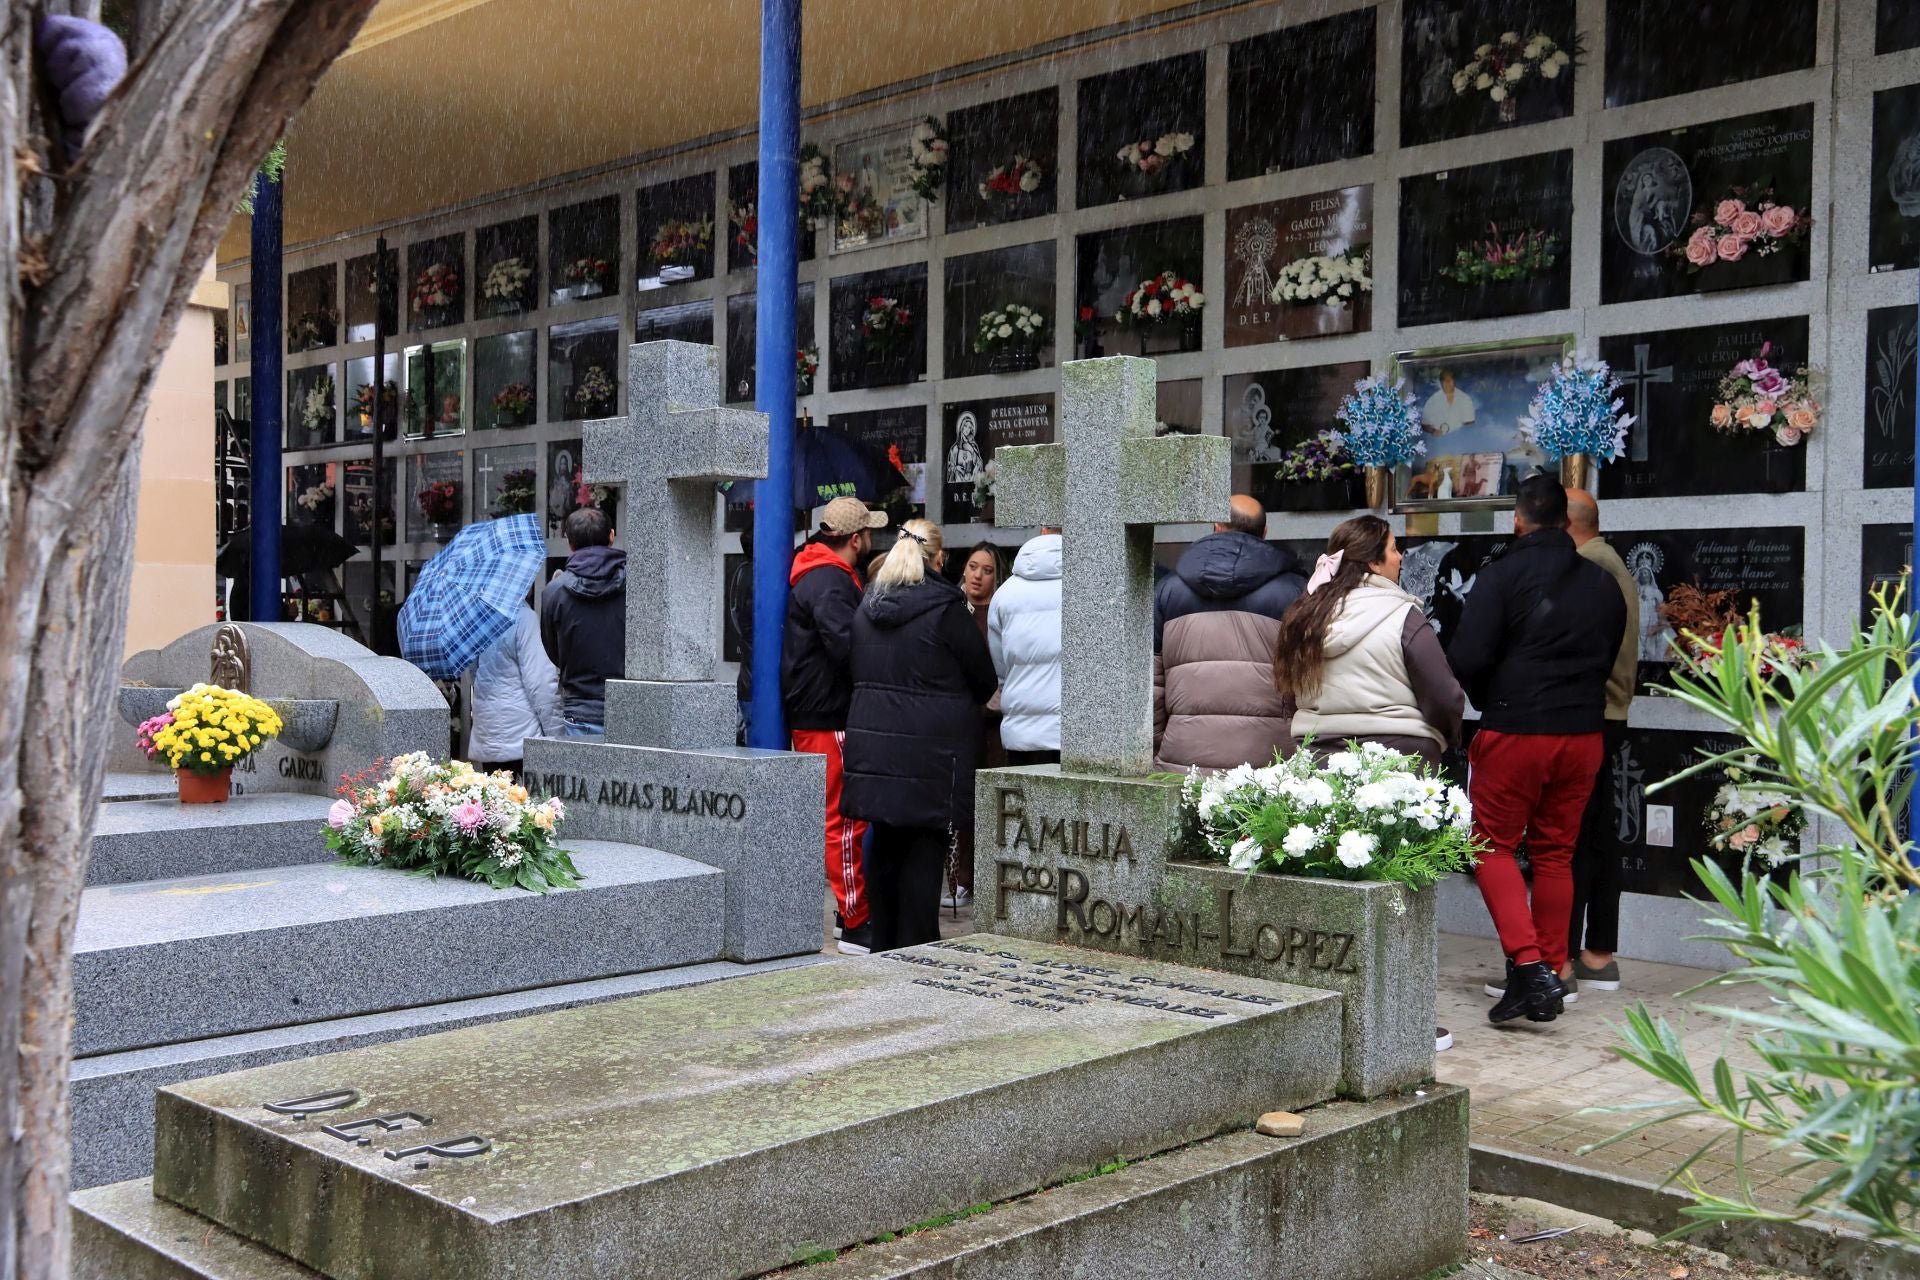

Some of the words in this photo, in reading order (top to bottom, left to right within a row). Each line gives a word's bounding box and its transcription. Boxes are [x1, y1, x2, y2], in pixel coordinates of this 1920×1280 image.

[1310, 197, 1341, 212] FELISA
[1291, 216, 1325, 231] GARCIA
[999, 406, 1021, 417] ELENA
[1024, 403, 1047, 415] AYUSO
[988, 418, 1011, 431] SANTA
[1696, 540, 1738, 556] Juliana
[278, 756, 327, 783] GARCIA
[523, 771, 589, 803] FAMILIA
[597, 780, 654, 810] ARIAS
[661, 785, 746, 821] BLANCO
[995, 785, 1138, 862] FAMILIA
[880, 952, 978, 973] CARLOS
[980, 971, 1070, 990] LOPEZ
[912, 978, 1004, 999] GRACIAS
[1032, 960, 1121, 977] LOPEZ
[1129, 976, 1284, 1006] GONZALEZ
